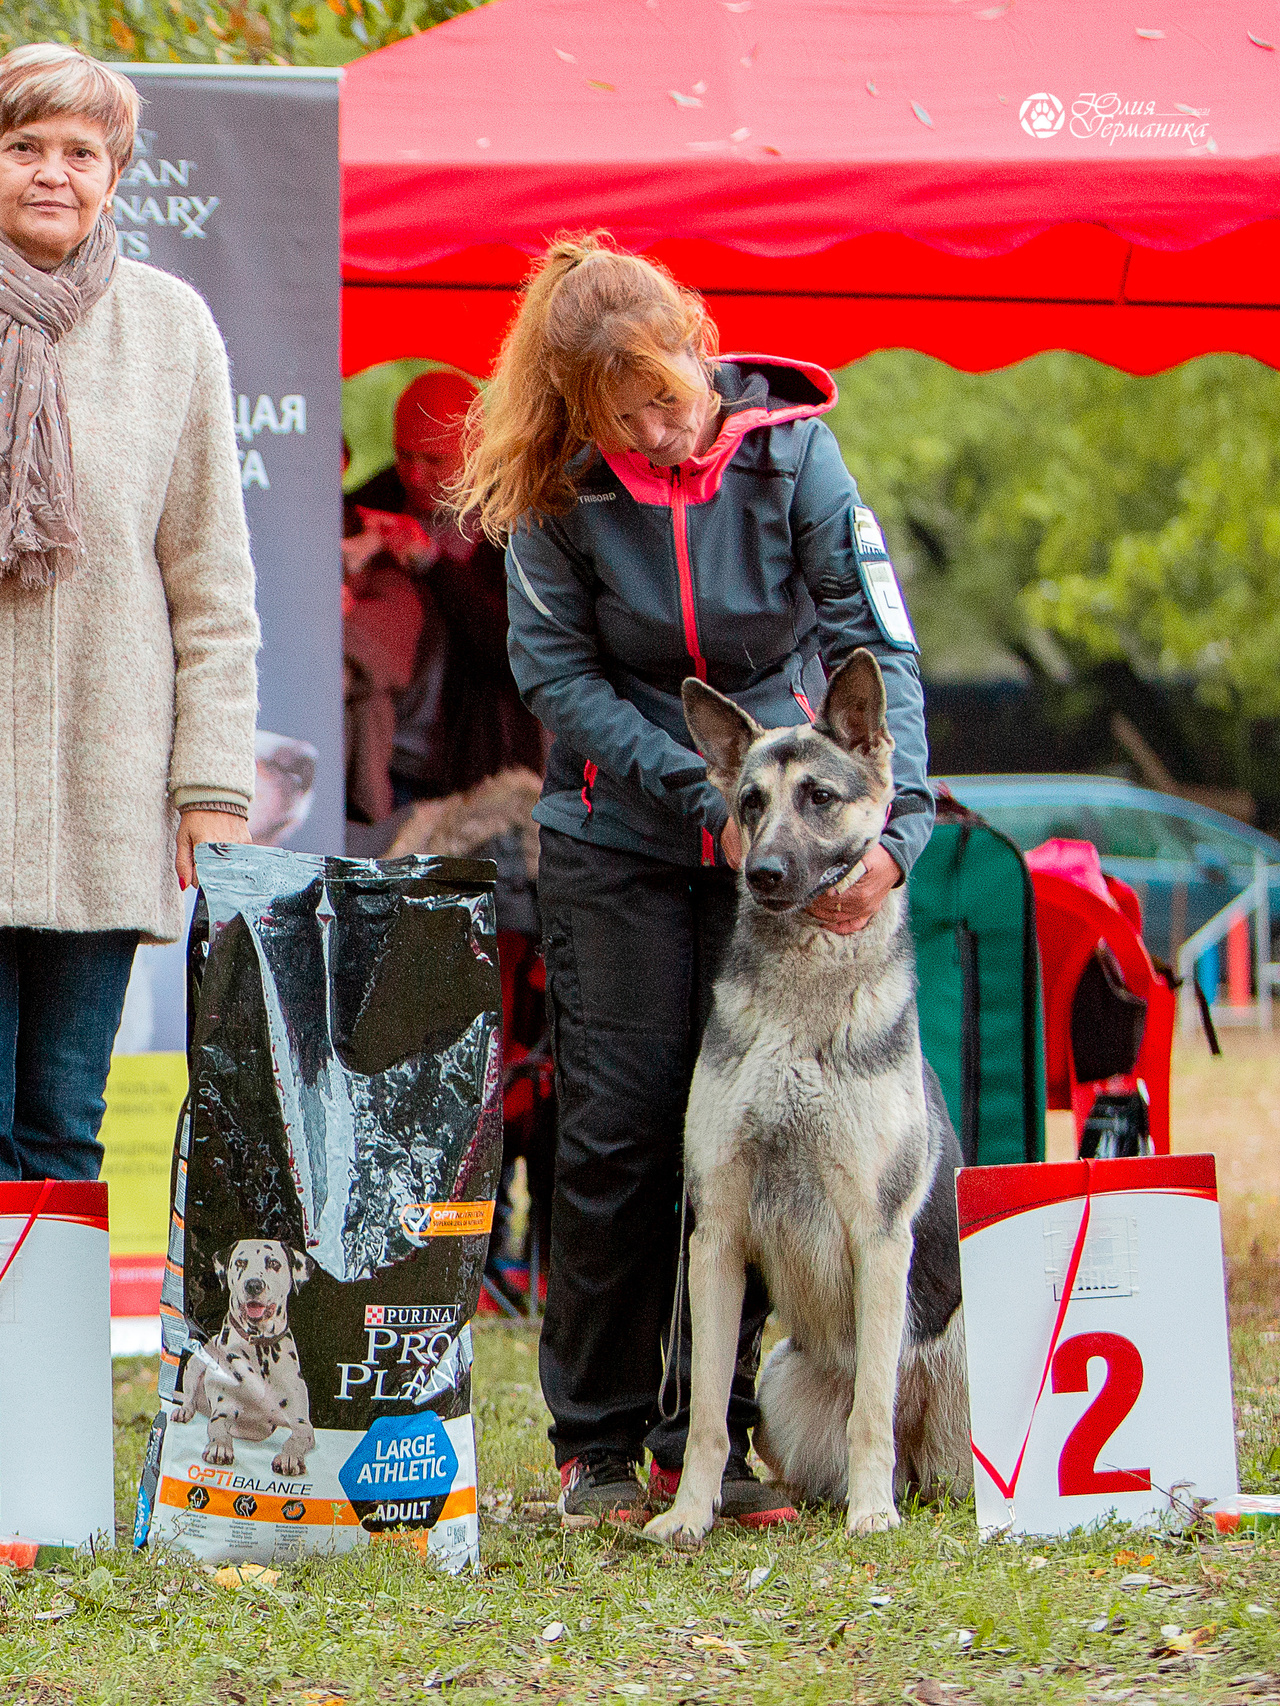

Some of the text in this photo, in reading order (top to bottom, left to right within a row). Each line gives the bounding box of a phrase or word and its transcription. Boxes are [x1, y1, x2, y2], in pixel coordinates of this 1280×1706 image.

[386, 1308, 452, 1324] PURINA
[361, 1327, 453, 1365] PRO
[334, 1362, 457, 1401] PLAN
[1051, 1330, 1152, 1497] 2
[376, 1433, 436, 1461] LARGE
[356, 1455, 447, 1484] ATHLETIC
[373, 1501, 431, 1522] ADULT
